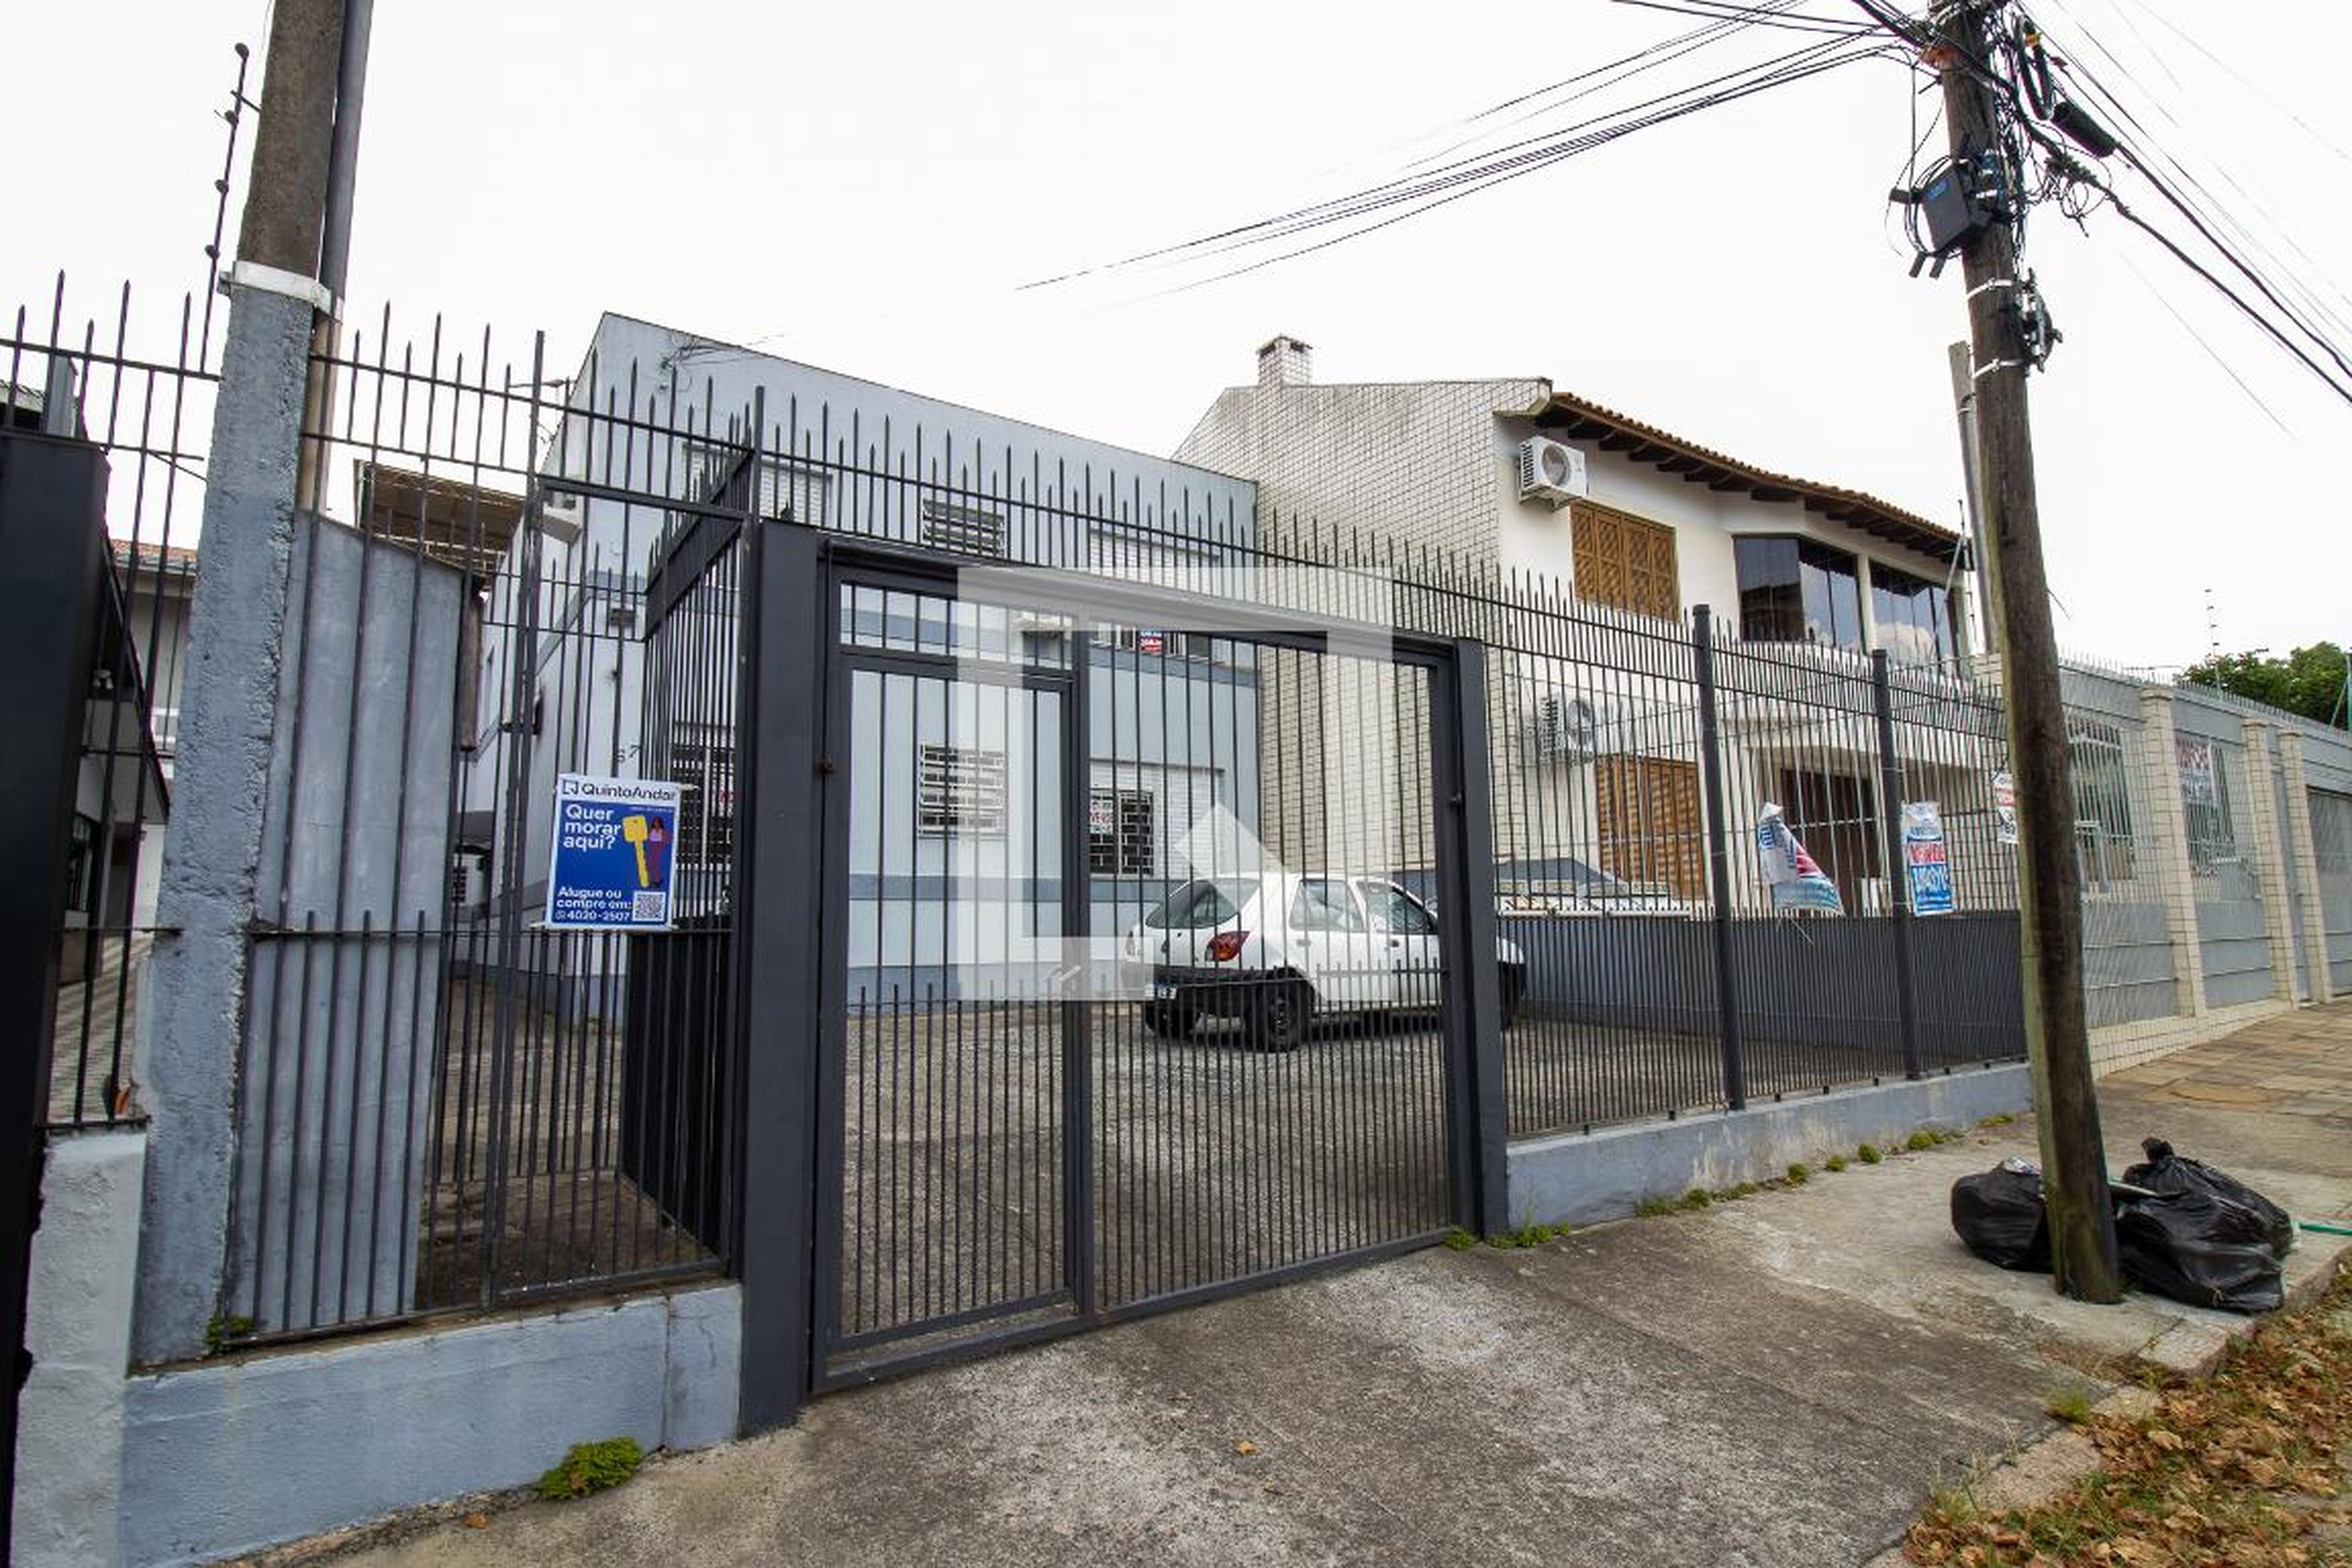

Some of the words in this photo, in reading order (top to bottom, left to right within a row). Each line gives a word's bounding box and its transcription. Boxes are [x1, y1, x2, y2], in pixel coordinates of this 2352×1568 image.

[581, 783, 675, 801] QuintoAndar
[566, 804, 614, 820] Quer
[565, 821, 622, 835] morar
[562, 835, 616, 852] aqui?
[558, 887, 603, 900] Alugue
[606, 890, 621, 899] ou
[557, 899, 606, 911] compre
[608, 901, 631, 910] em:
